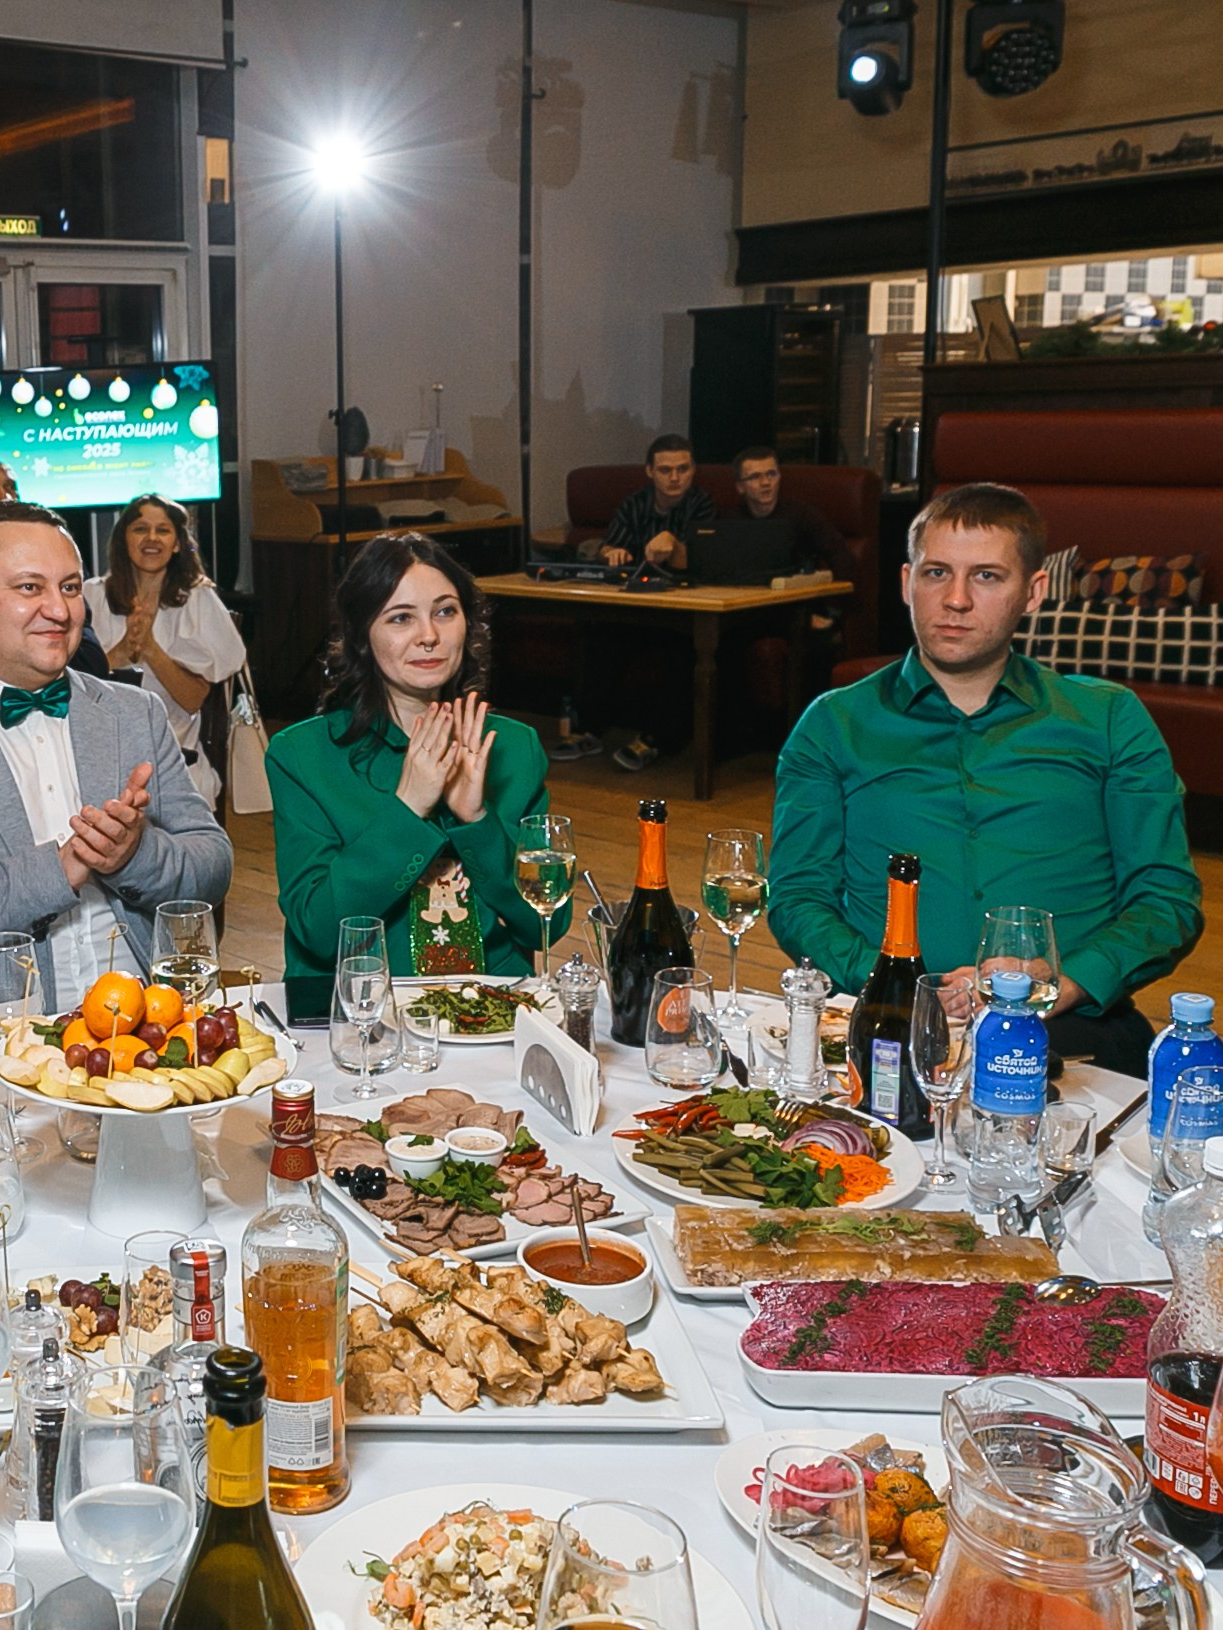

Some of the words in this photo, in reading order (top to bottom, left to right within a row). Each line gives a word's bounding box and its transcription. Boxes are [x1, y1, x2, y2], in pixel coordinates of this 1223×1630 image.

[23, 429, 35, 442] С
[38, 421, 179, 442] НАСТУПАЮЩИМ
[82, 443, 121, 459] 2025
